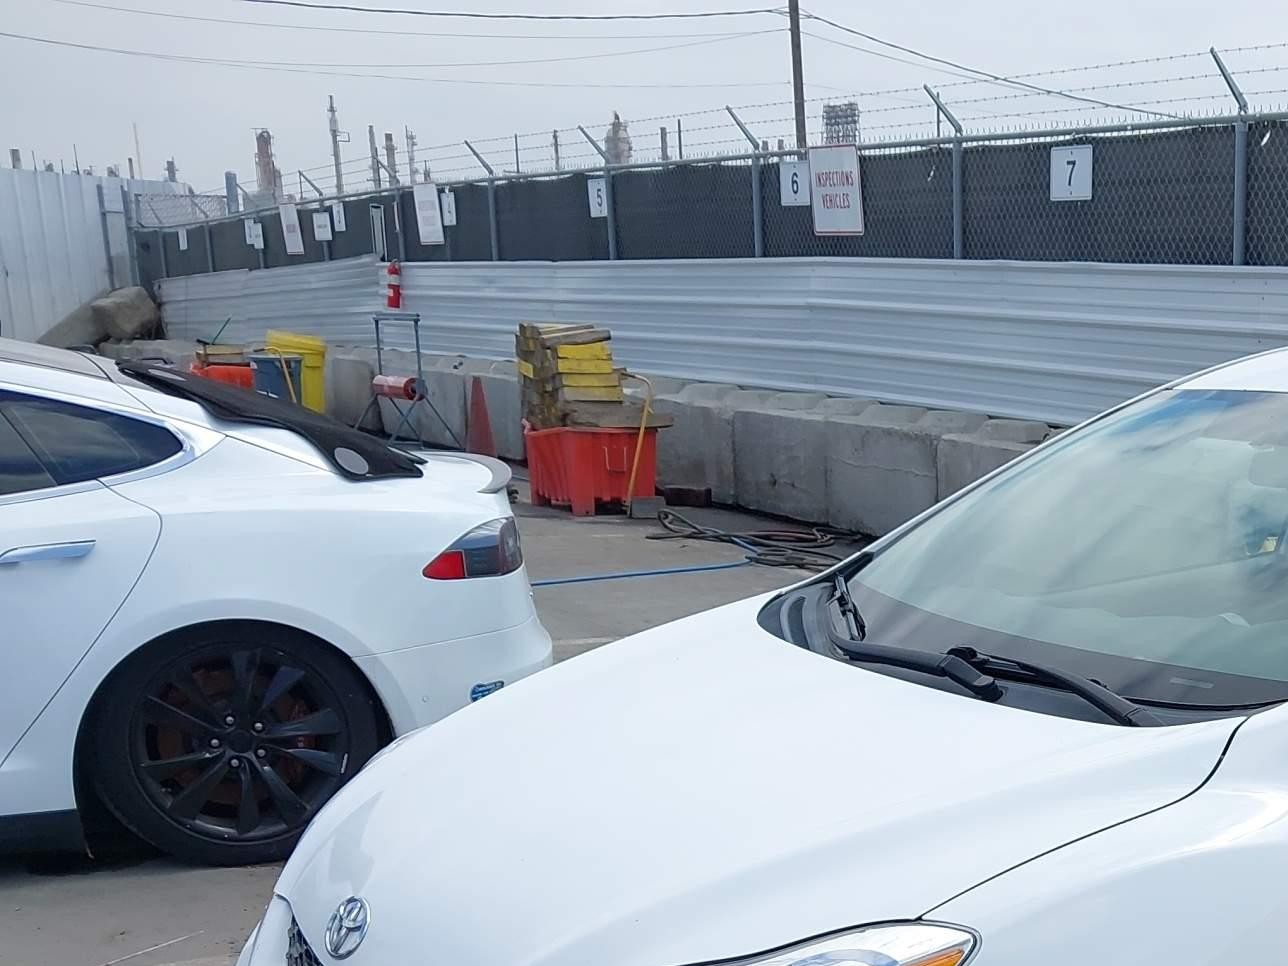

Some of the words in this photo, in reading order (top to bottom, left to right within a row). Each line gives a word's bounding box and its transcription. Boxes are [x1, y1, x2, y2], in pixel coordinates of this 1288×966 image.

[791, 171, 800, 195] 6
[815, 170, 854, 188] INSPECTIONS
[1066, 159, 1077, 187] 7
[596, 187, 603, 208] 5
[821, 192, 851, 210] VEHICLES
